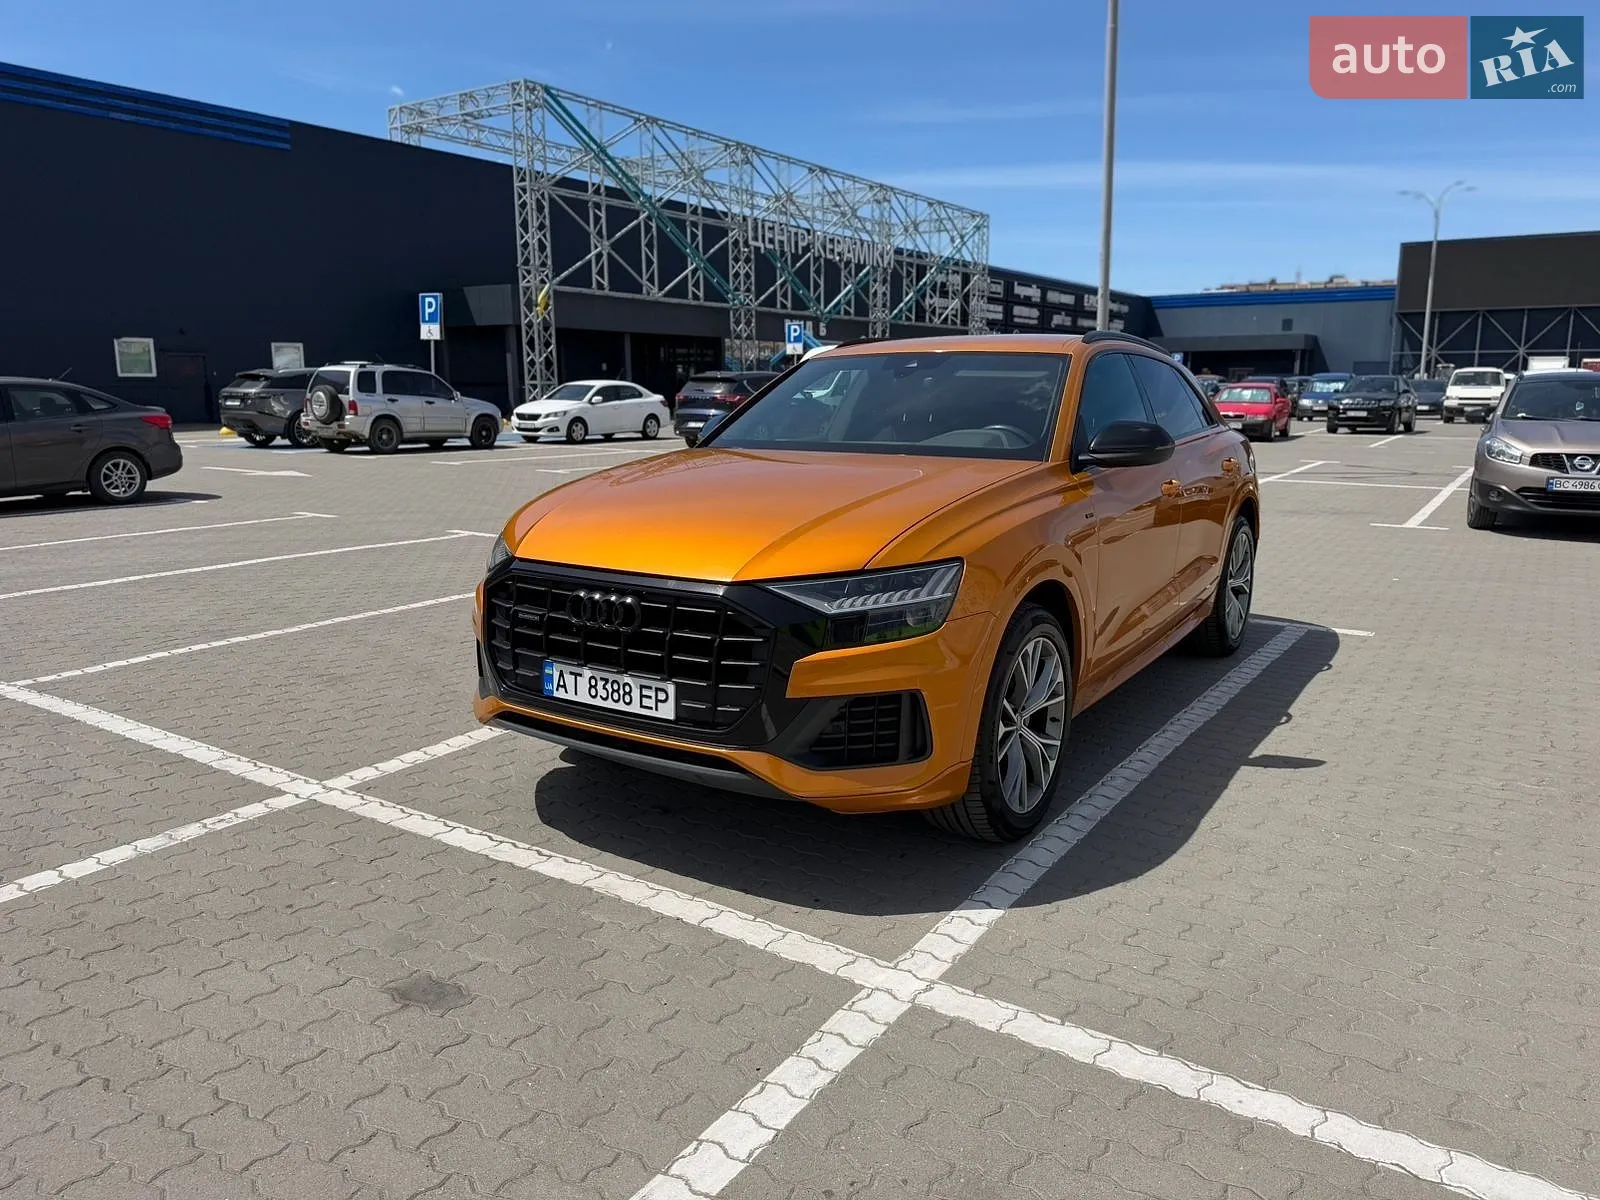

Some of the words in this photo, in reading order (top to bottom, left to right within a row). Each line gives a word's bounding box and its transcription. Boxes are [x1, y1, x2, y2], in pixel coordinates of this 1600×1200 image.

[747, 217, 808, 255] ЦЕНТР
[814, 231, 894, 268] КЕРАМІКИ
[425, 297, 436, 321] P
[790, 325, 800, 342] P
[1555, 480, 1570, 489] BC
[1571, 480, 1596, 490] 4986
[556, 670, 583, 696] AT
[588, 676, 633, 705] 8388
[639, 684, 669, 711] EP
